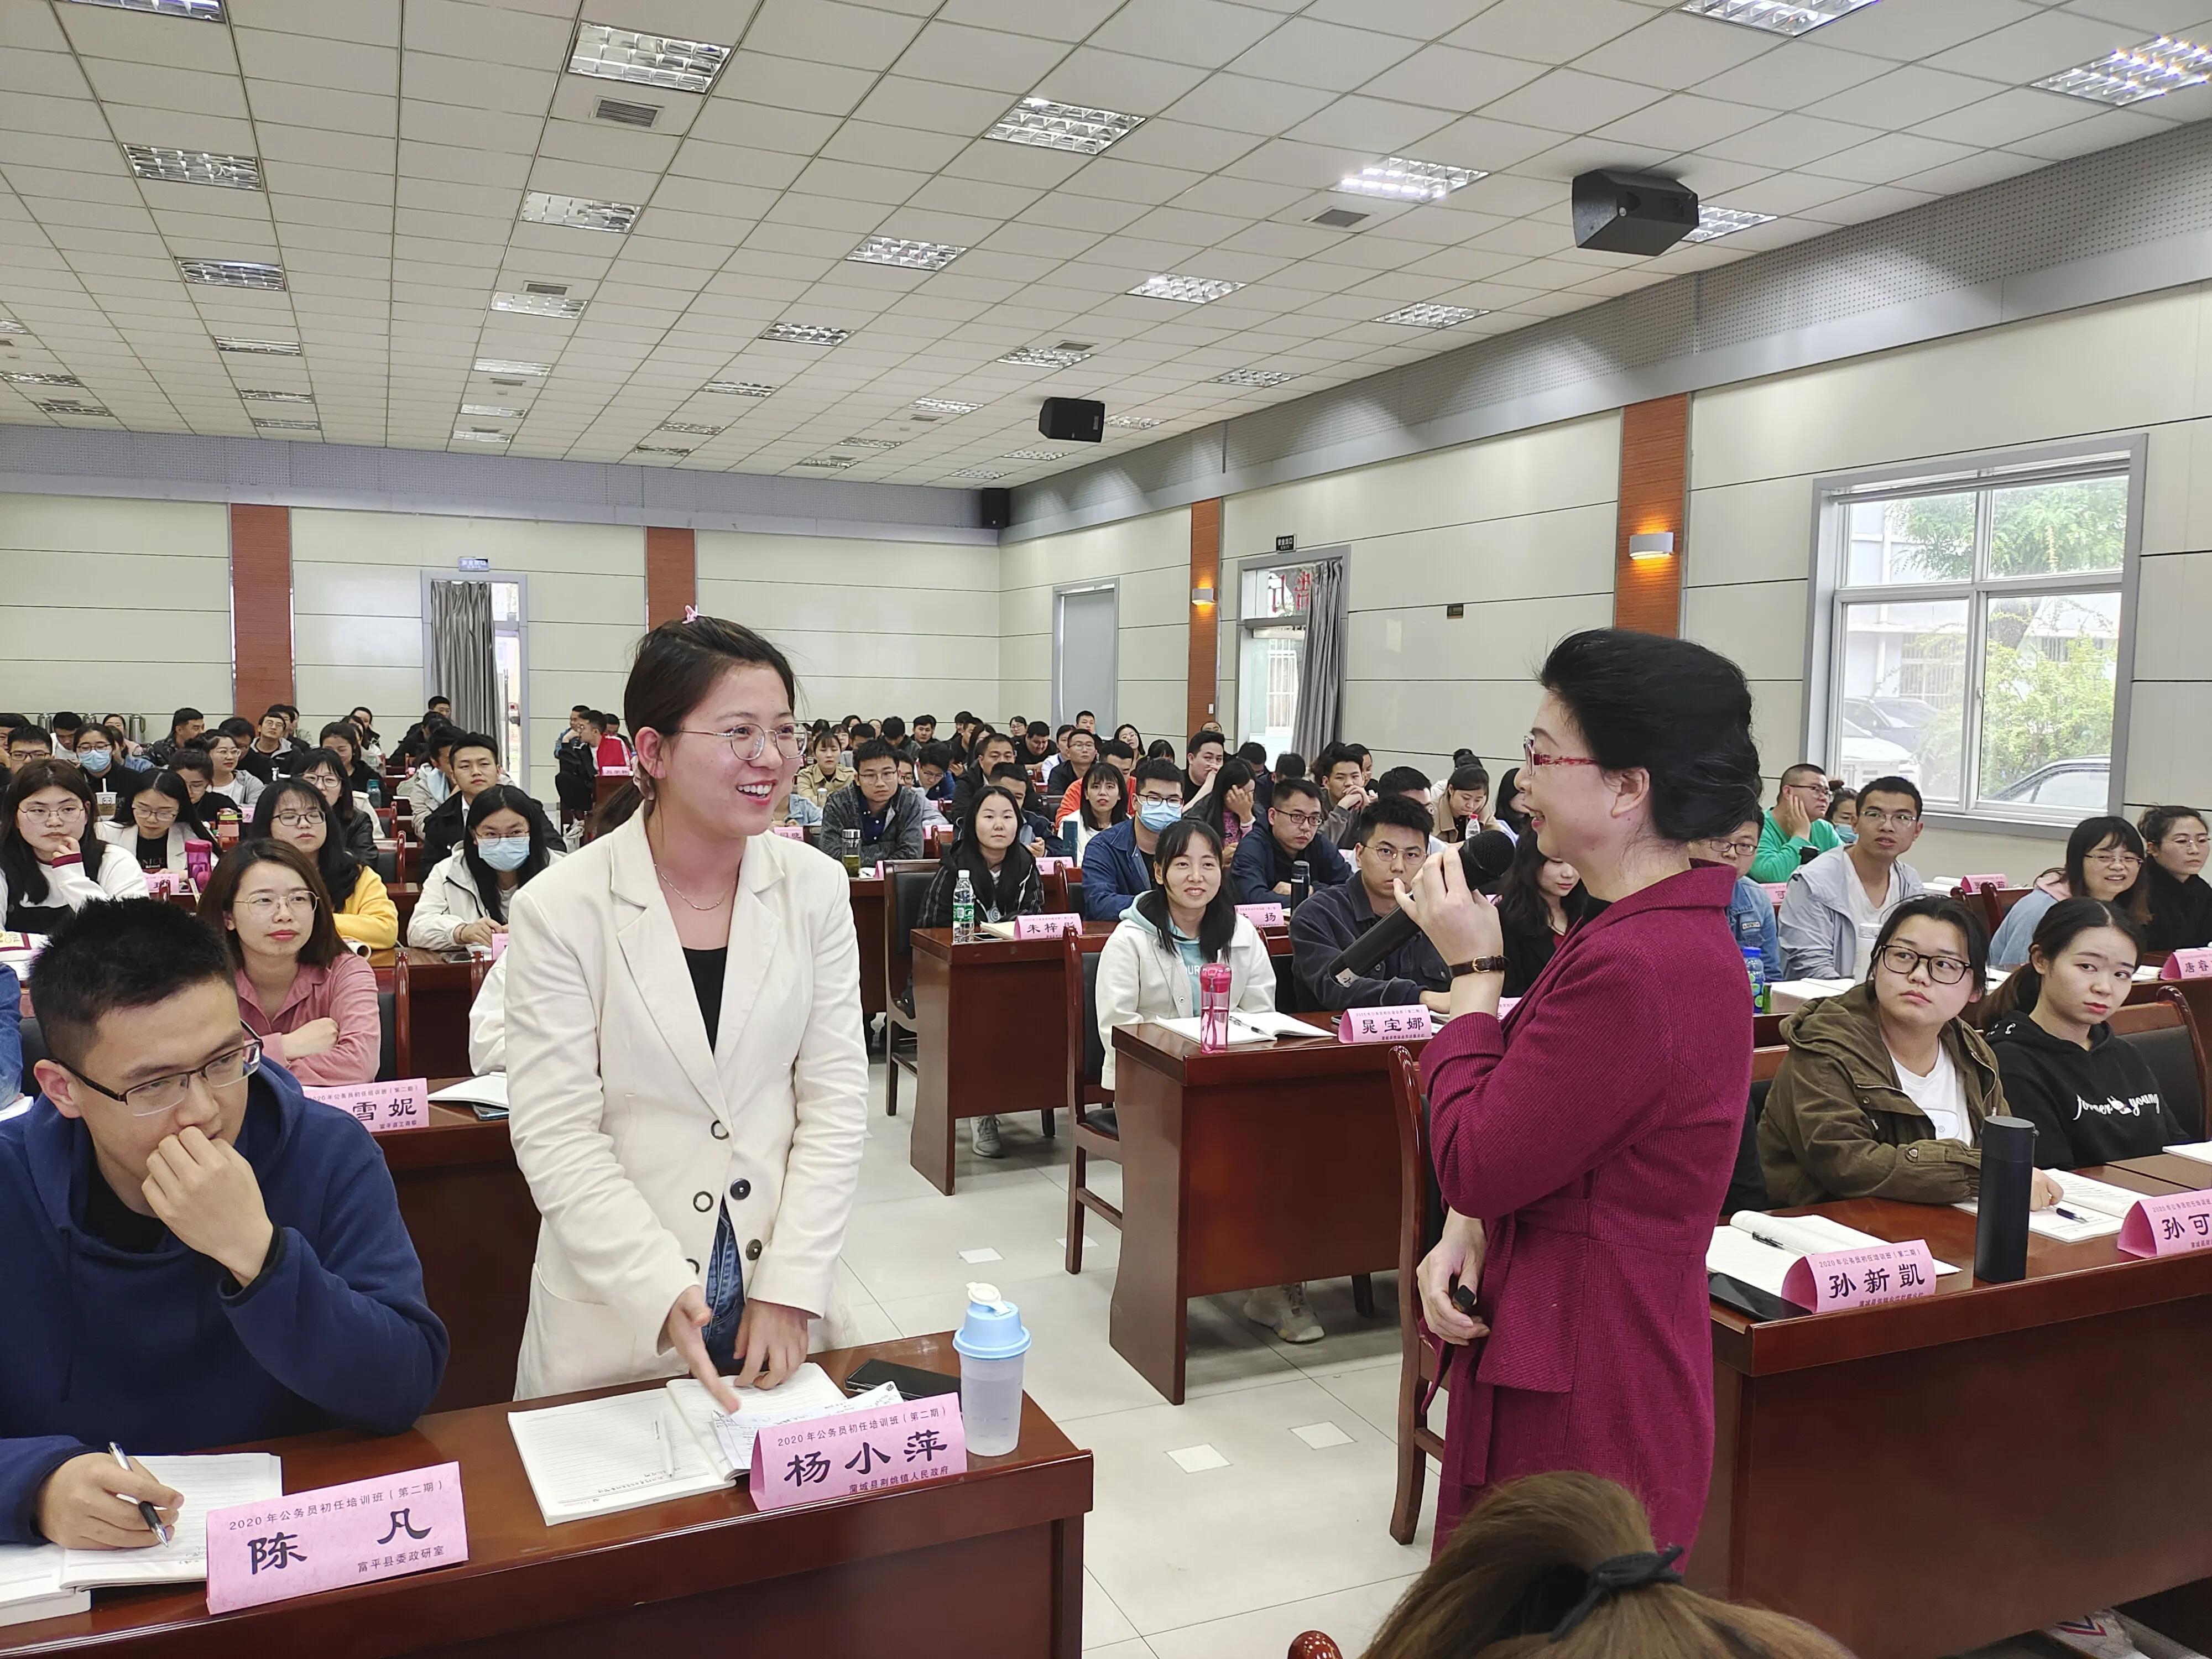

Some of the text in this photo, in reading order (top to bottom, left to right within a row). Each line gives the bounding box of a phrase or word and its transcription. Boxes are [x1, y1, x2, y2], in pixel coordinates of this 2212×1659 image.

[1361, 1017, 1424, 1034] 晁宝娜
[2162, 1213, 2210, 1240] 孙可
[784, 1430, 947, 1487] 杨小萍
[357, 1545, 445, 1574] 富平县委政研室
